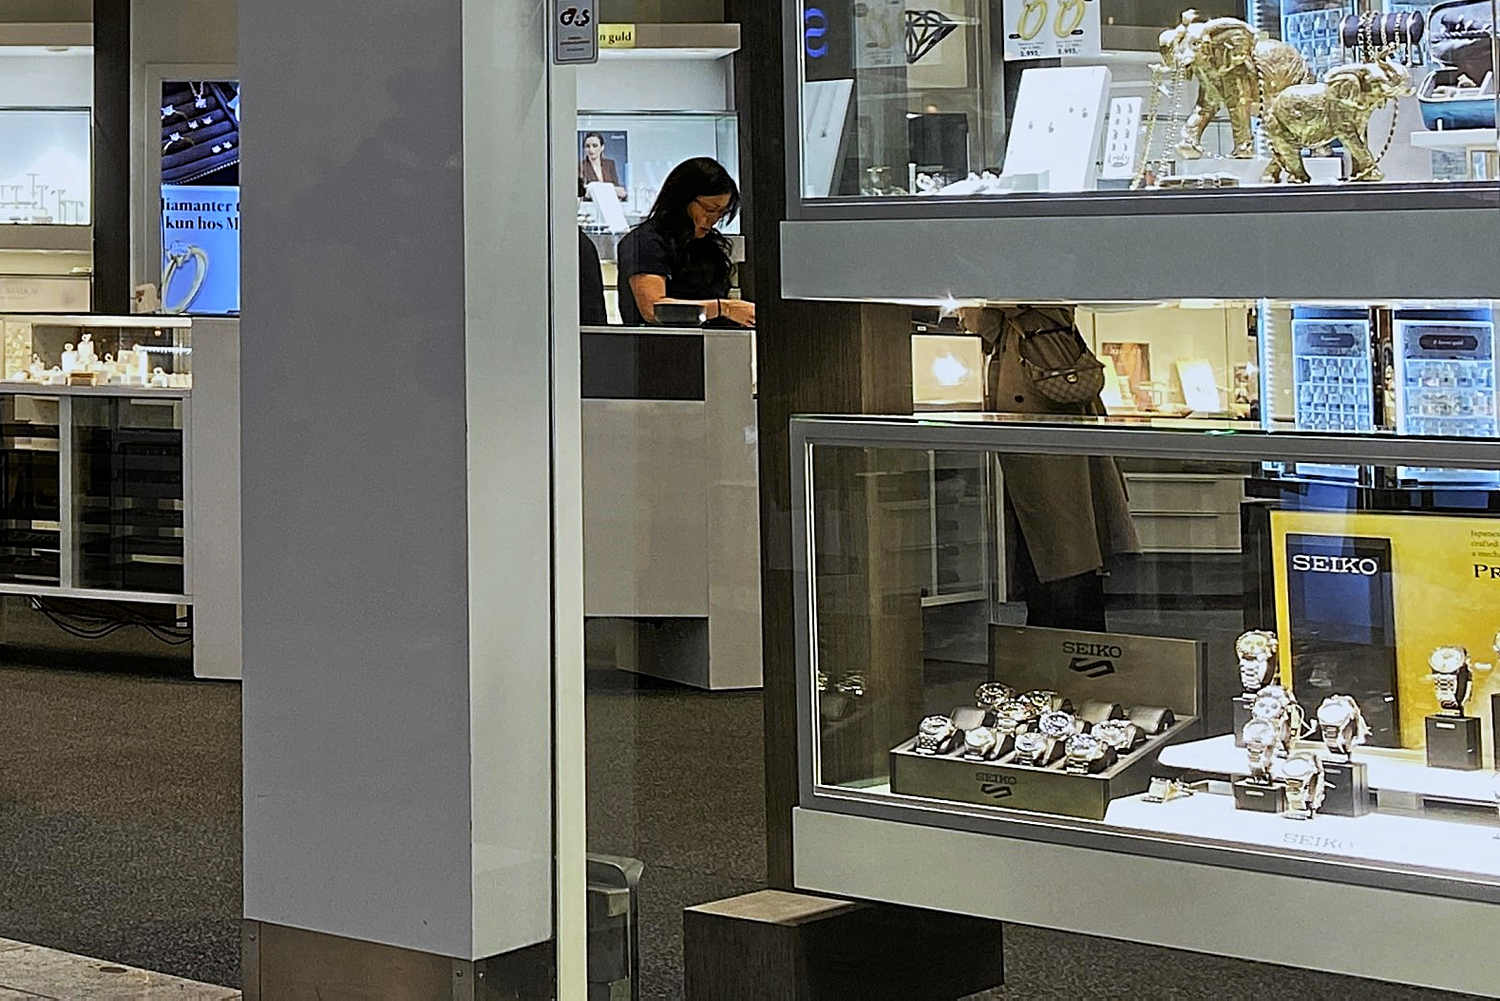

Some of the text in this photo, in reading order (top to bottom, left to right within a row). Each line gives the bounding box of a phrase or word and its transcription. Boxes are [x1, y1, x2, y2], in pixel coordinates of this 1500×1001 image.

[608, 31, 632, 45] guld
[165, 215, 194, 230] kun
[197, 215, 224, 230] hos
[1292, 554, 1378, 576] SEIKO
[1473, 563, 1500, 579] PR
[1062, 641, 1123, 659] SEIKO
[975, 771, 1018, 786] SEIKO
